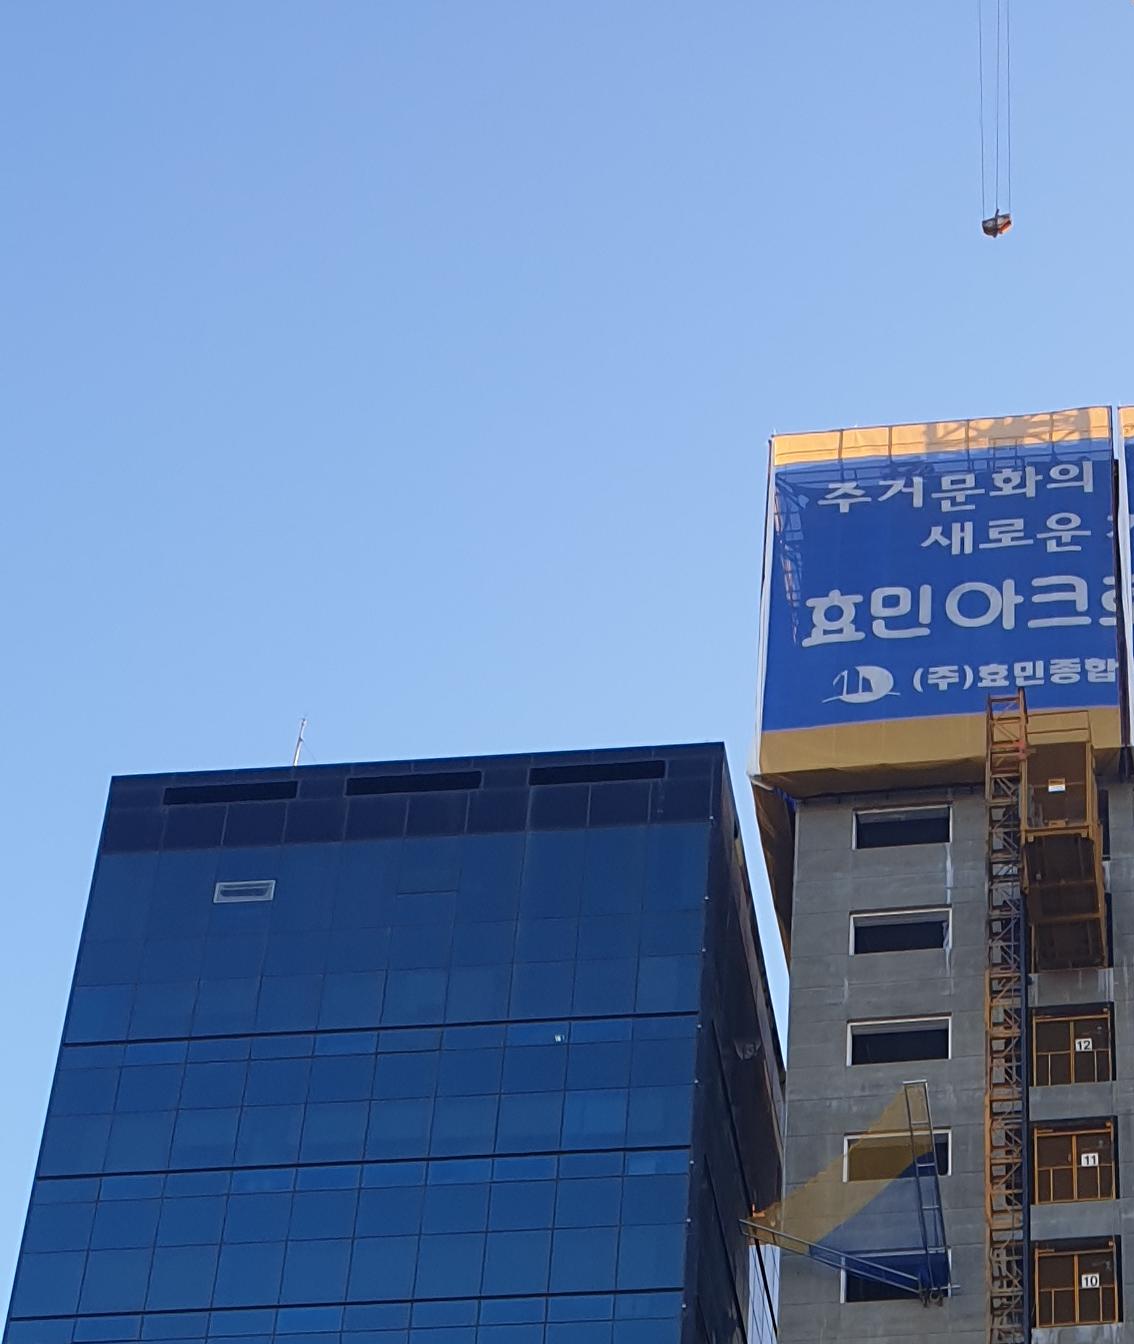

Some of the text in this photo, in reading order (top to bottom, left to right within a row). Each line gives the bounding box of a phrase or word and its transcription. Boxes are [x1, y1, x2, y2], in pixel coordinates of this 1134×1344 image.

[817, 460, 1093, 513] 주거문화의
[920, 512, 1091, 555] 새로운
[1077, 1040, 1091, 1050] 12
[1084, 1154, 1096, 1166] 11
[1085, 1275, 1098, 1287] 10
